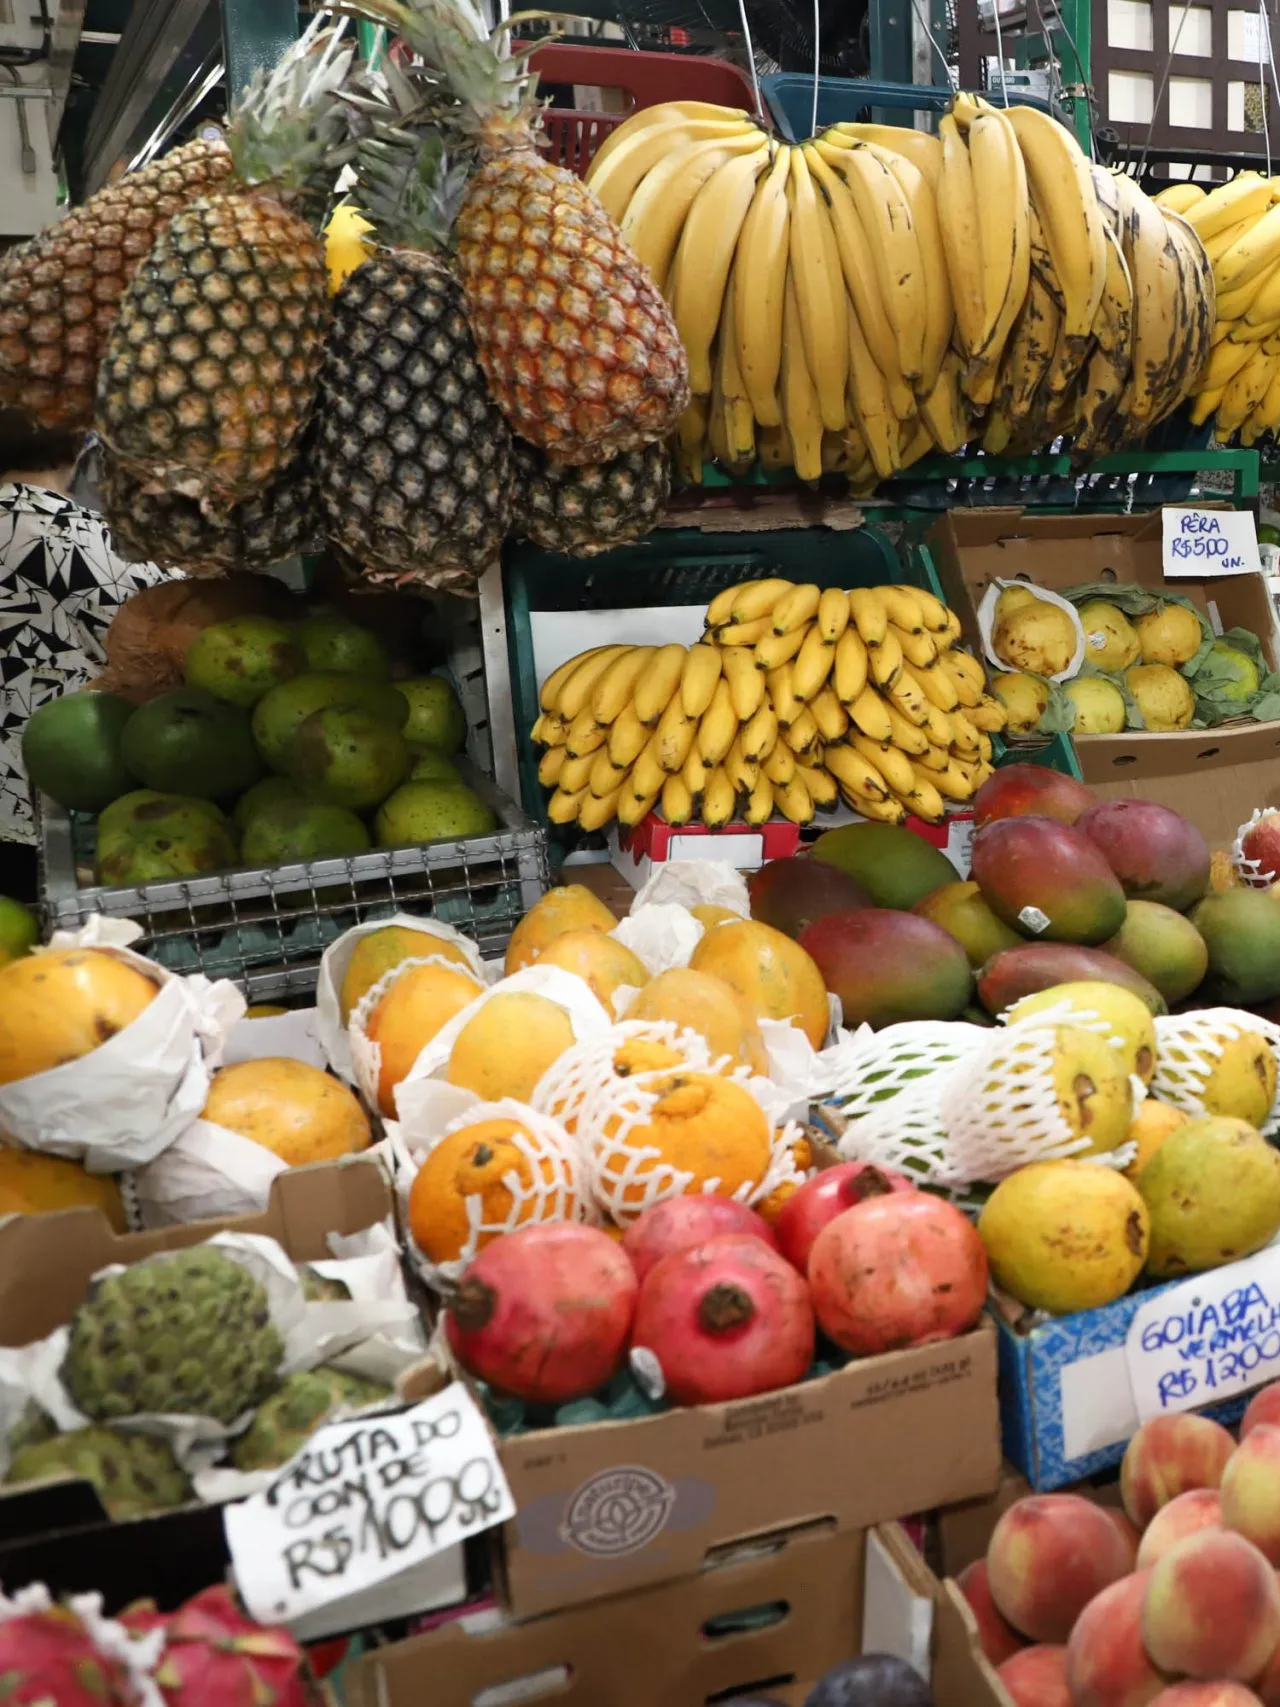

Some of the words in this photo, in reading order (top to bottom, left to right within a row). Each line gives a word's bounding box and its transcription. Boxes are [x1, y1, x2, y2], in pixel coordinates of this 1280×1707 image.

[1181, 512, 1220, 534] PÊRA
[1141, 1281, 1269, 1352] GOIABA
[411, 1411, 460, 1447] DO
